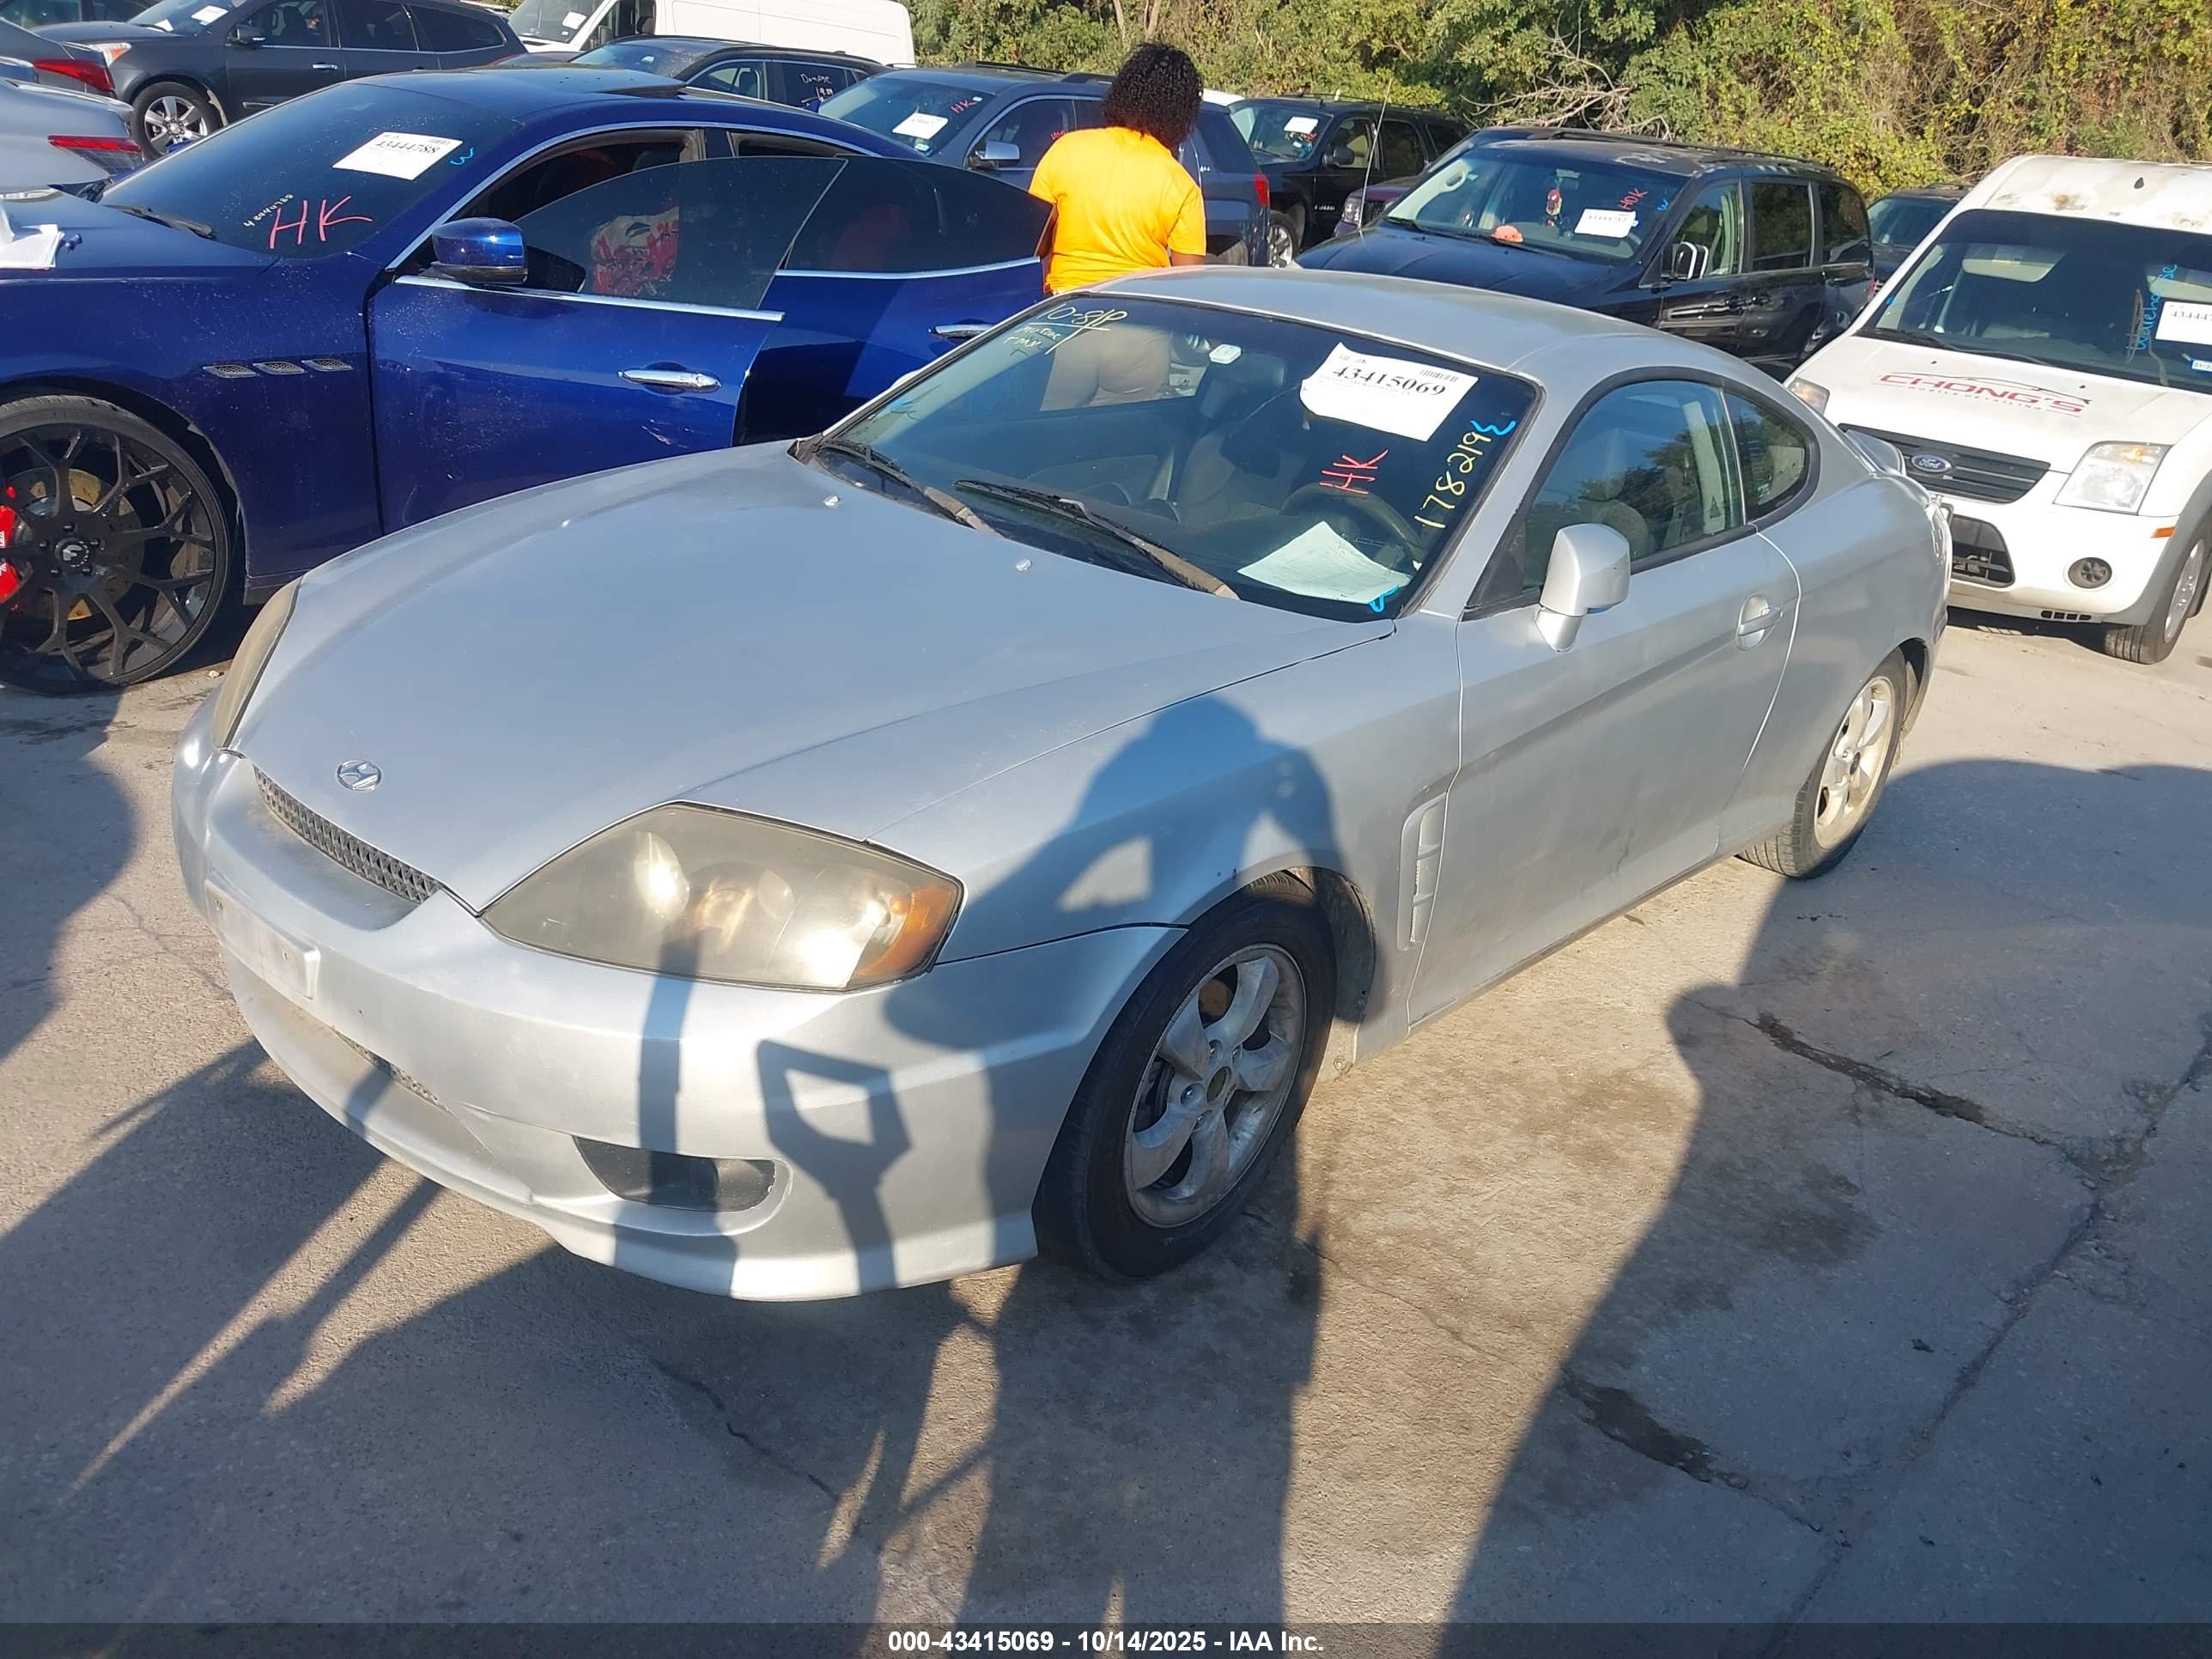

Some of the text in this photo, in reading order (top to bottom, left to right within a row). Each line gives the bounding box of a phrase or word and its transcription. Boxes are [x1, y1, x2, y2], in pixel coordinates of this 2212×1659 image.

[950, 99, 978, 114] HK
[269, 196, 373, 249] HK
[1333, 367, 1446, 395] 43415069
[1880, 374, 2084, 413] CHONG'S
[1320, 449, 1389, 495] HK
[1414, 431, 1492, 528] 178219
